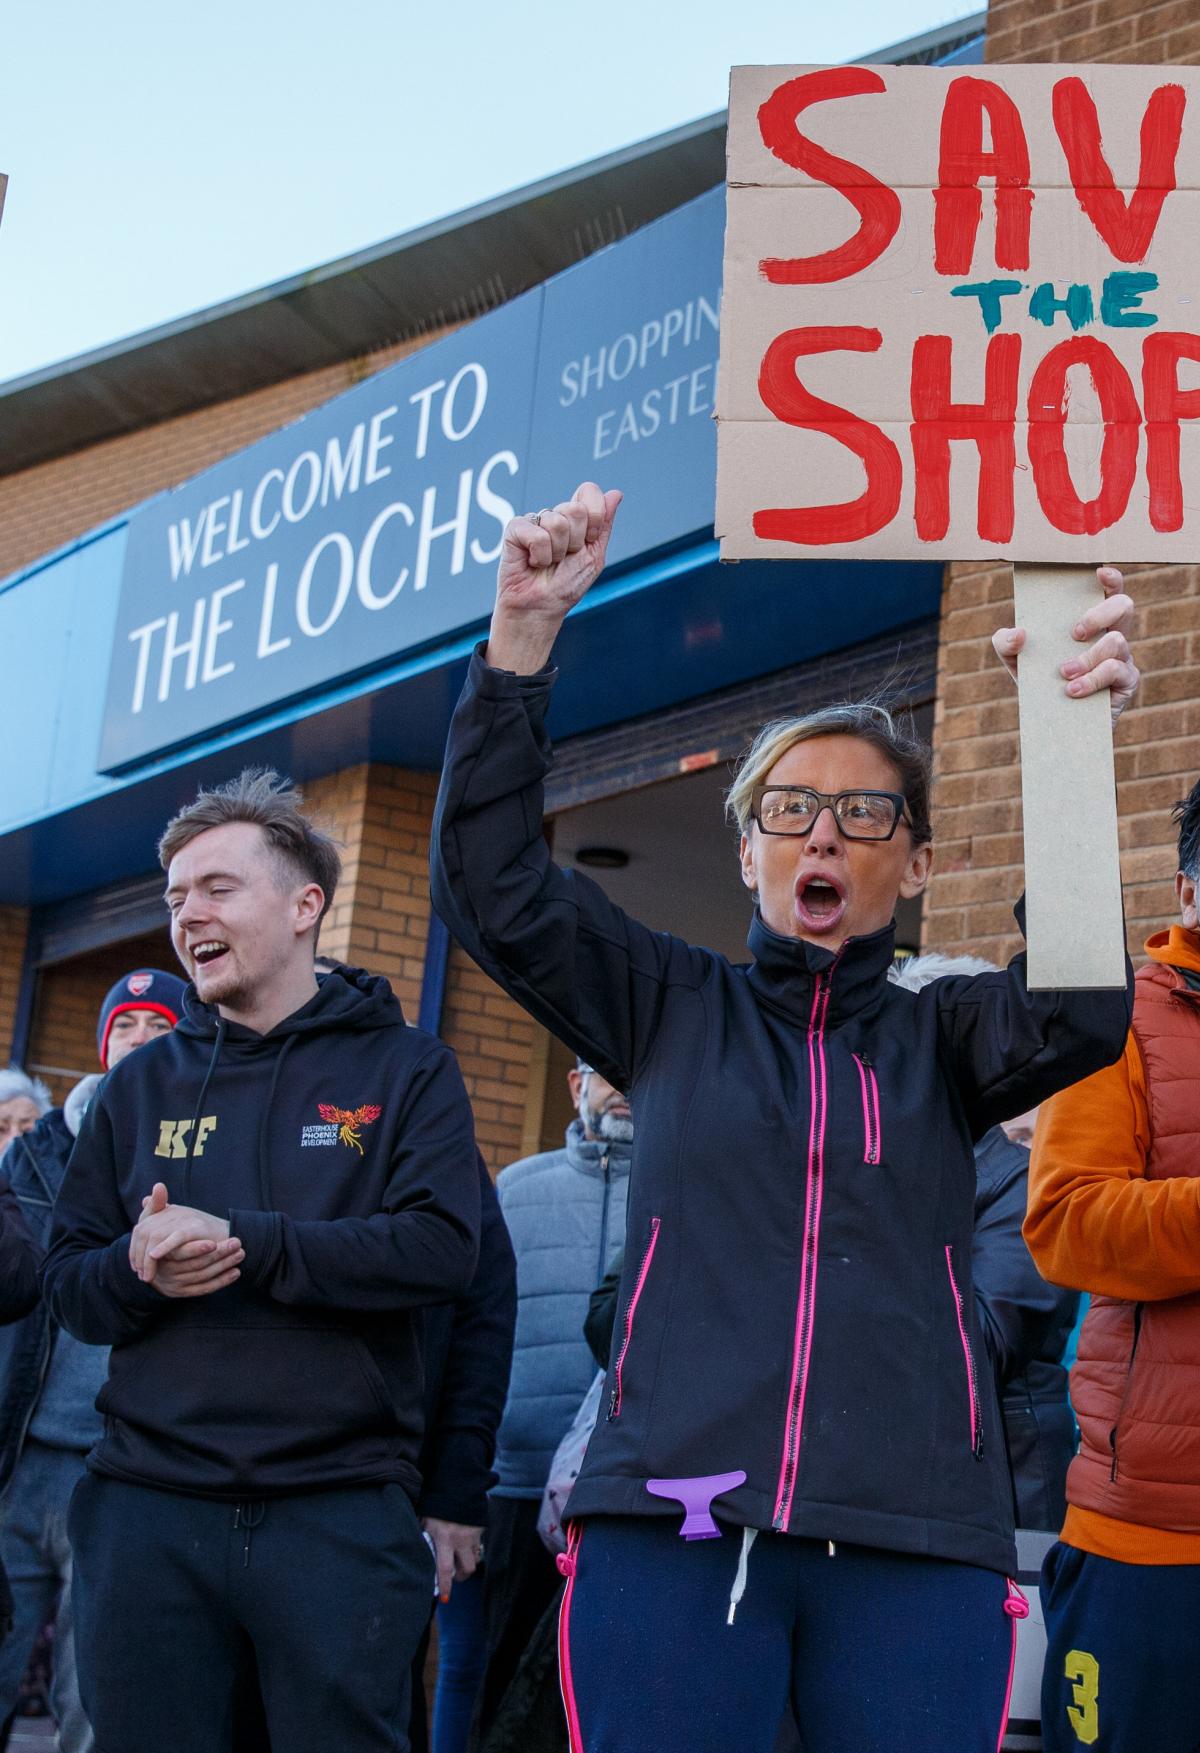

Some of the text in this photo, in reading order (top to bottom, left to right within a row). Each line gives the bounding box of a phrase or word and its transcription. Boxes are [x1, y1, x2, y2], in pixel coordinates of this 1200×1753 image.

[950, 271, 1160, 335] THE
[593, 360, 720, 460] EASTE
[168, 362, 488, 583] WELCOME TO
[129, 450, 519, 714] THE LOCHS
[154, 1115, 217, 1158] KF
[301, 1138, 337, 1147] DEVELOPMENT
[302, 1124, 339, 1133] EASTERHOUSE
[1065, 1649, 1099, 1745] 3
